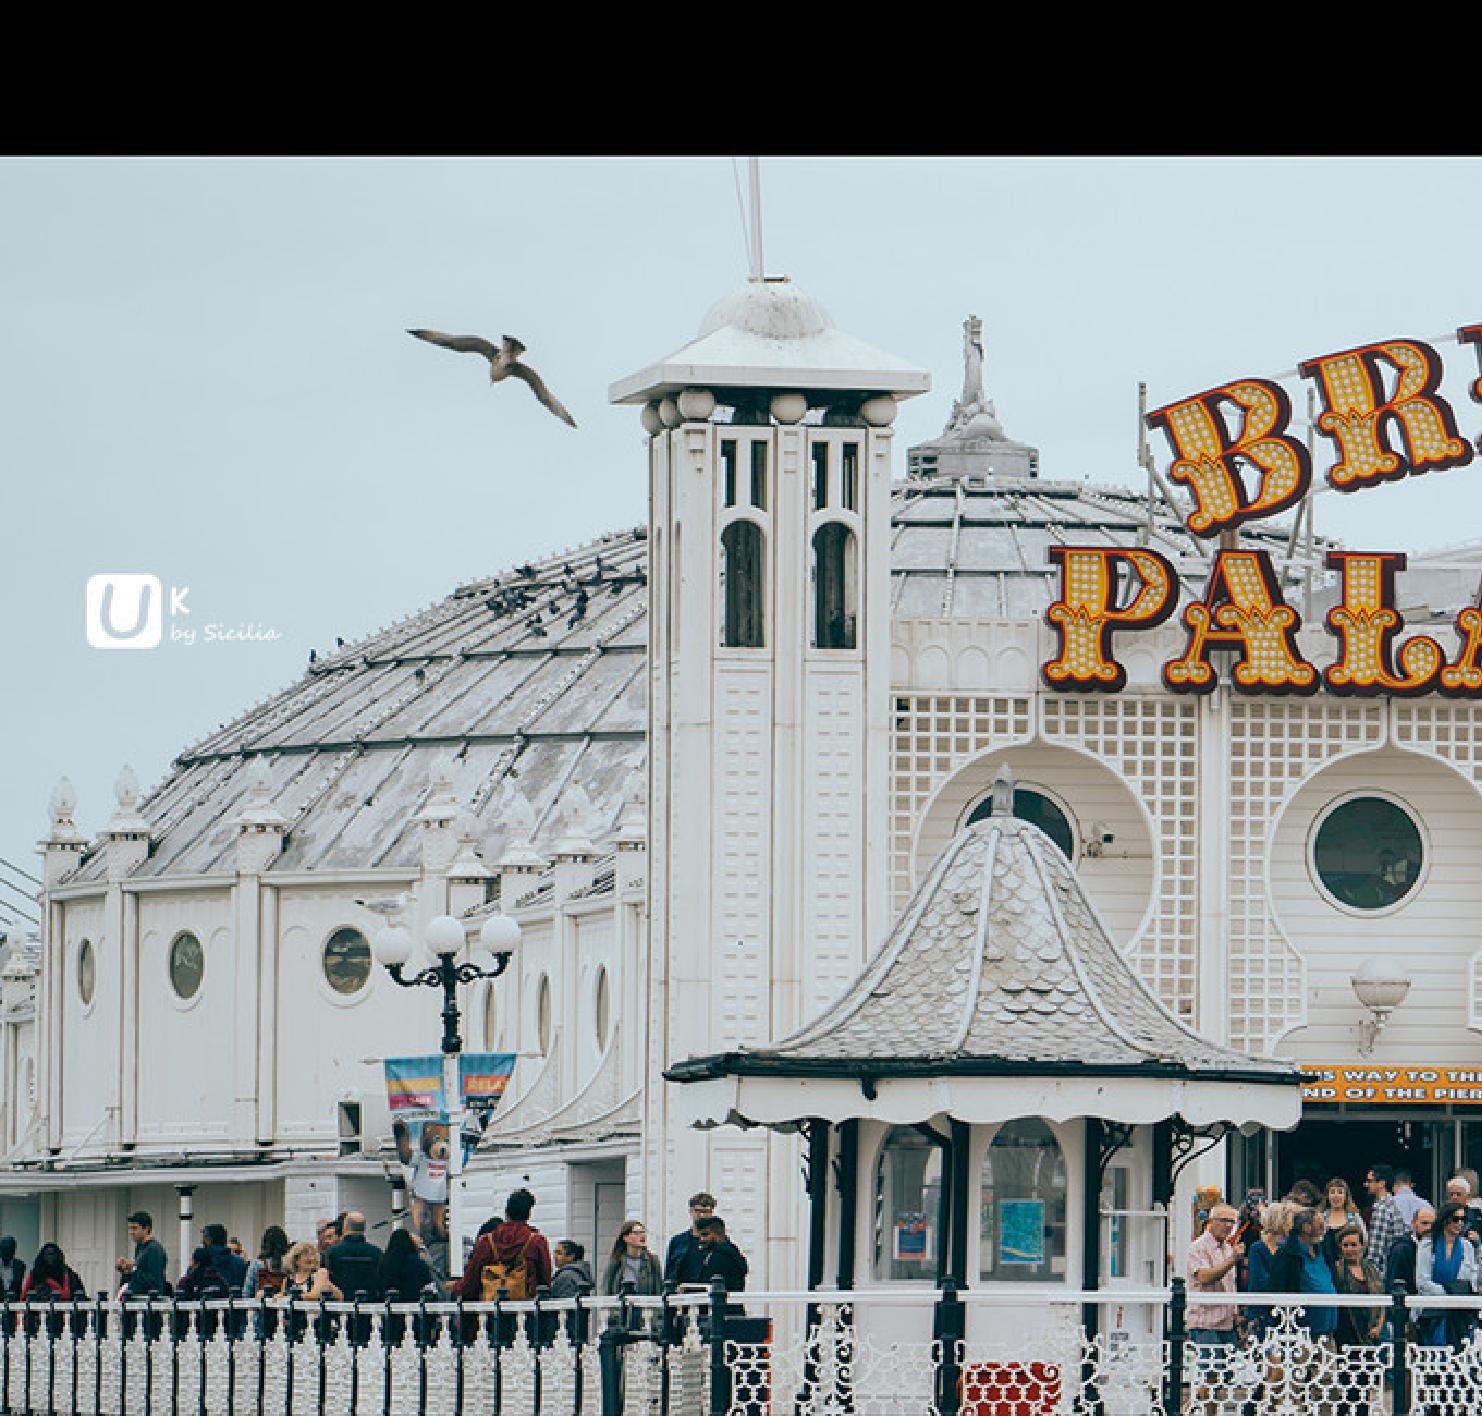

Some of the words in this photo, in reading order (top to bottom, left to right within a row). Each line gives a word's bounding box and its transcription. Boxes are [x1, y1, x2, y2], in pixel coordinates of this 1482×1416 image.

[1344, 1071, 1399, 1082] WAY
[1405, 1071, 1438, 1082] TO
[1346, 1088, 1377, 1099] OF
[1384, 1088, 1426, 1099] THE
